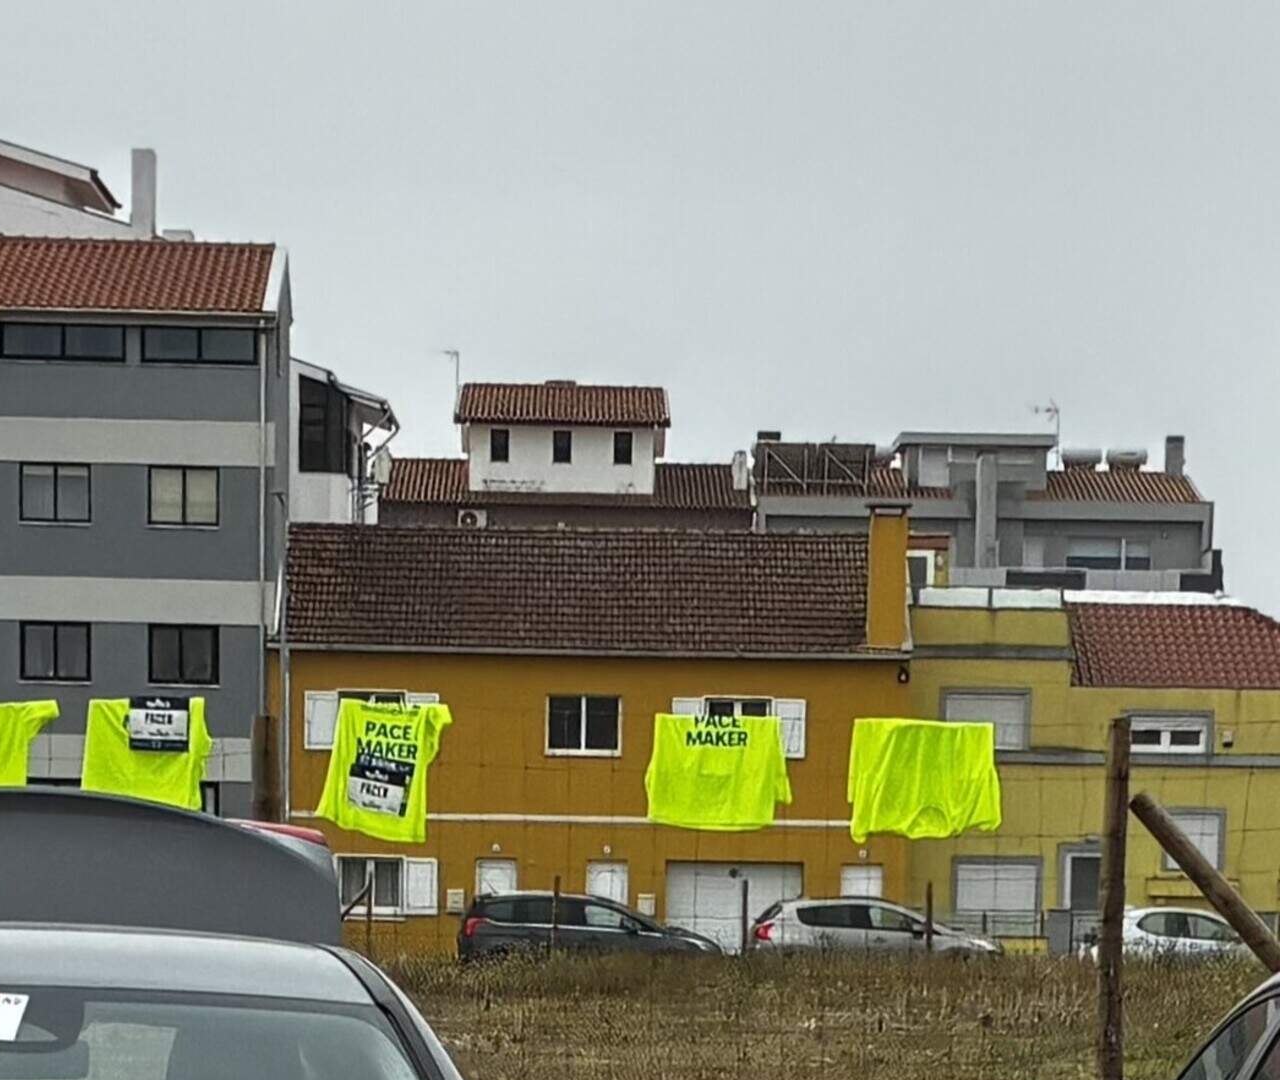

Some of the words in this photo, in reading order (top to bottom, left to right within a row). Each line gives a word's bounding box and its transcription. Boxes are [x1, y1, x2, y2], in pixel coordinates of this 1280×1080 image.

[365, 721, 412, 741] PACE
[686, 731, 748, 747] MAKER
[357, 737, 418, 759] MAKER
